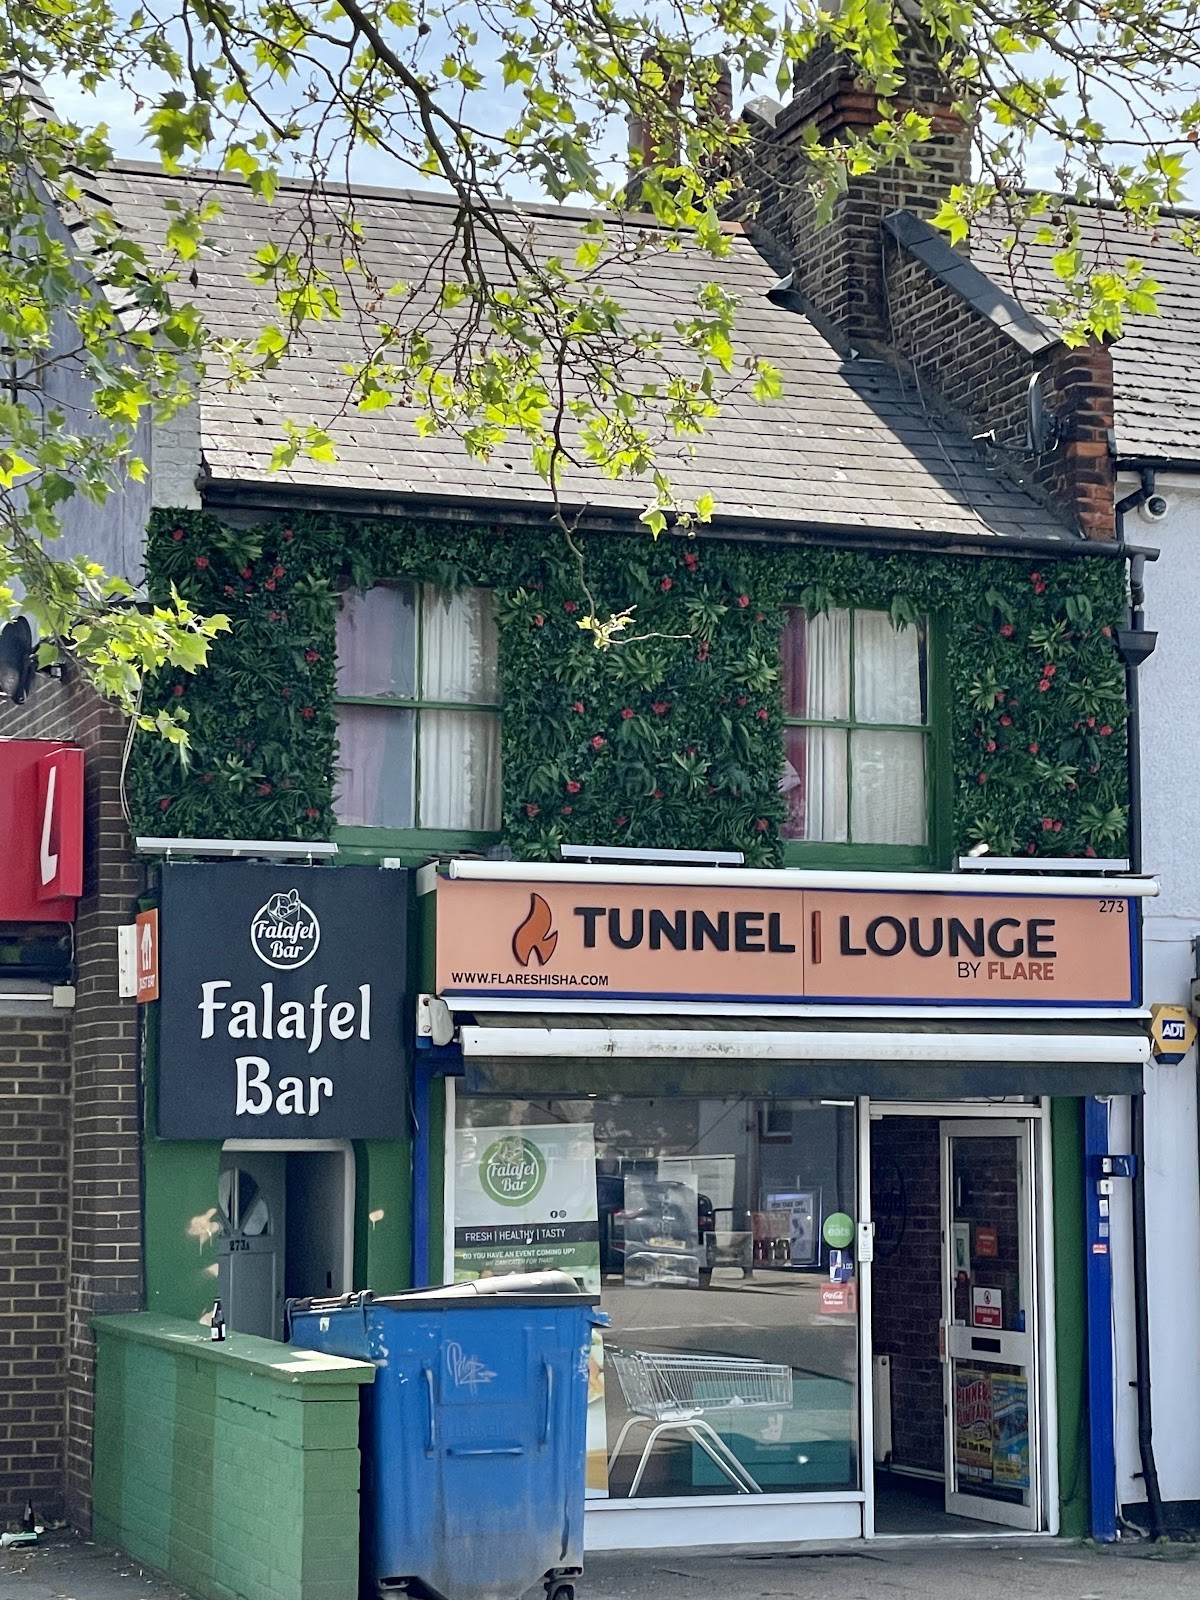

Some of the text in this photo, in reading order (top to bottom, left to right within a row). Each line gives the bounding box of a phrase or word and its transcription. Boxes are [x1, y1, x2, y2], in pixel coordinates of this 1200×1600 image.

[1099, 900, 1124, 913] 273
[253, 920, 314, 944] Falafel
[574, 907, 1057, 958] TUNNEL LOUNGE
[270, 940, 303, 958] Bar
[452, 972, 609, 986] WWW.FLARESHISHA.COM
[958, 962, 1054, 980] BY FLARE
[198, 980, 371, 1054] Falafel
[1162, 1023, 1185, 1038] ADT
[235, 1056, 334, 1116] Bar
[490, 1162, 535, 1179] Falafel
[501, 1177, 527, 1192] Bar
[465, 1228, 566, 1242] FRESH HEALTHY TASTY
[463, 1252, 472, 1260] DO
[473, 1252, 486, 1260] YOU
[487, 1251, 504, 1259] HAVE
[505, 1250, 514, 1258] AN
[515, 1249, 536, 1257] EVENT
[536, 1248, 561, 1257] COMING
